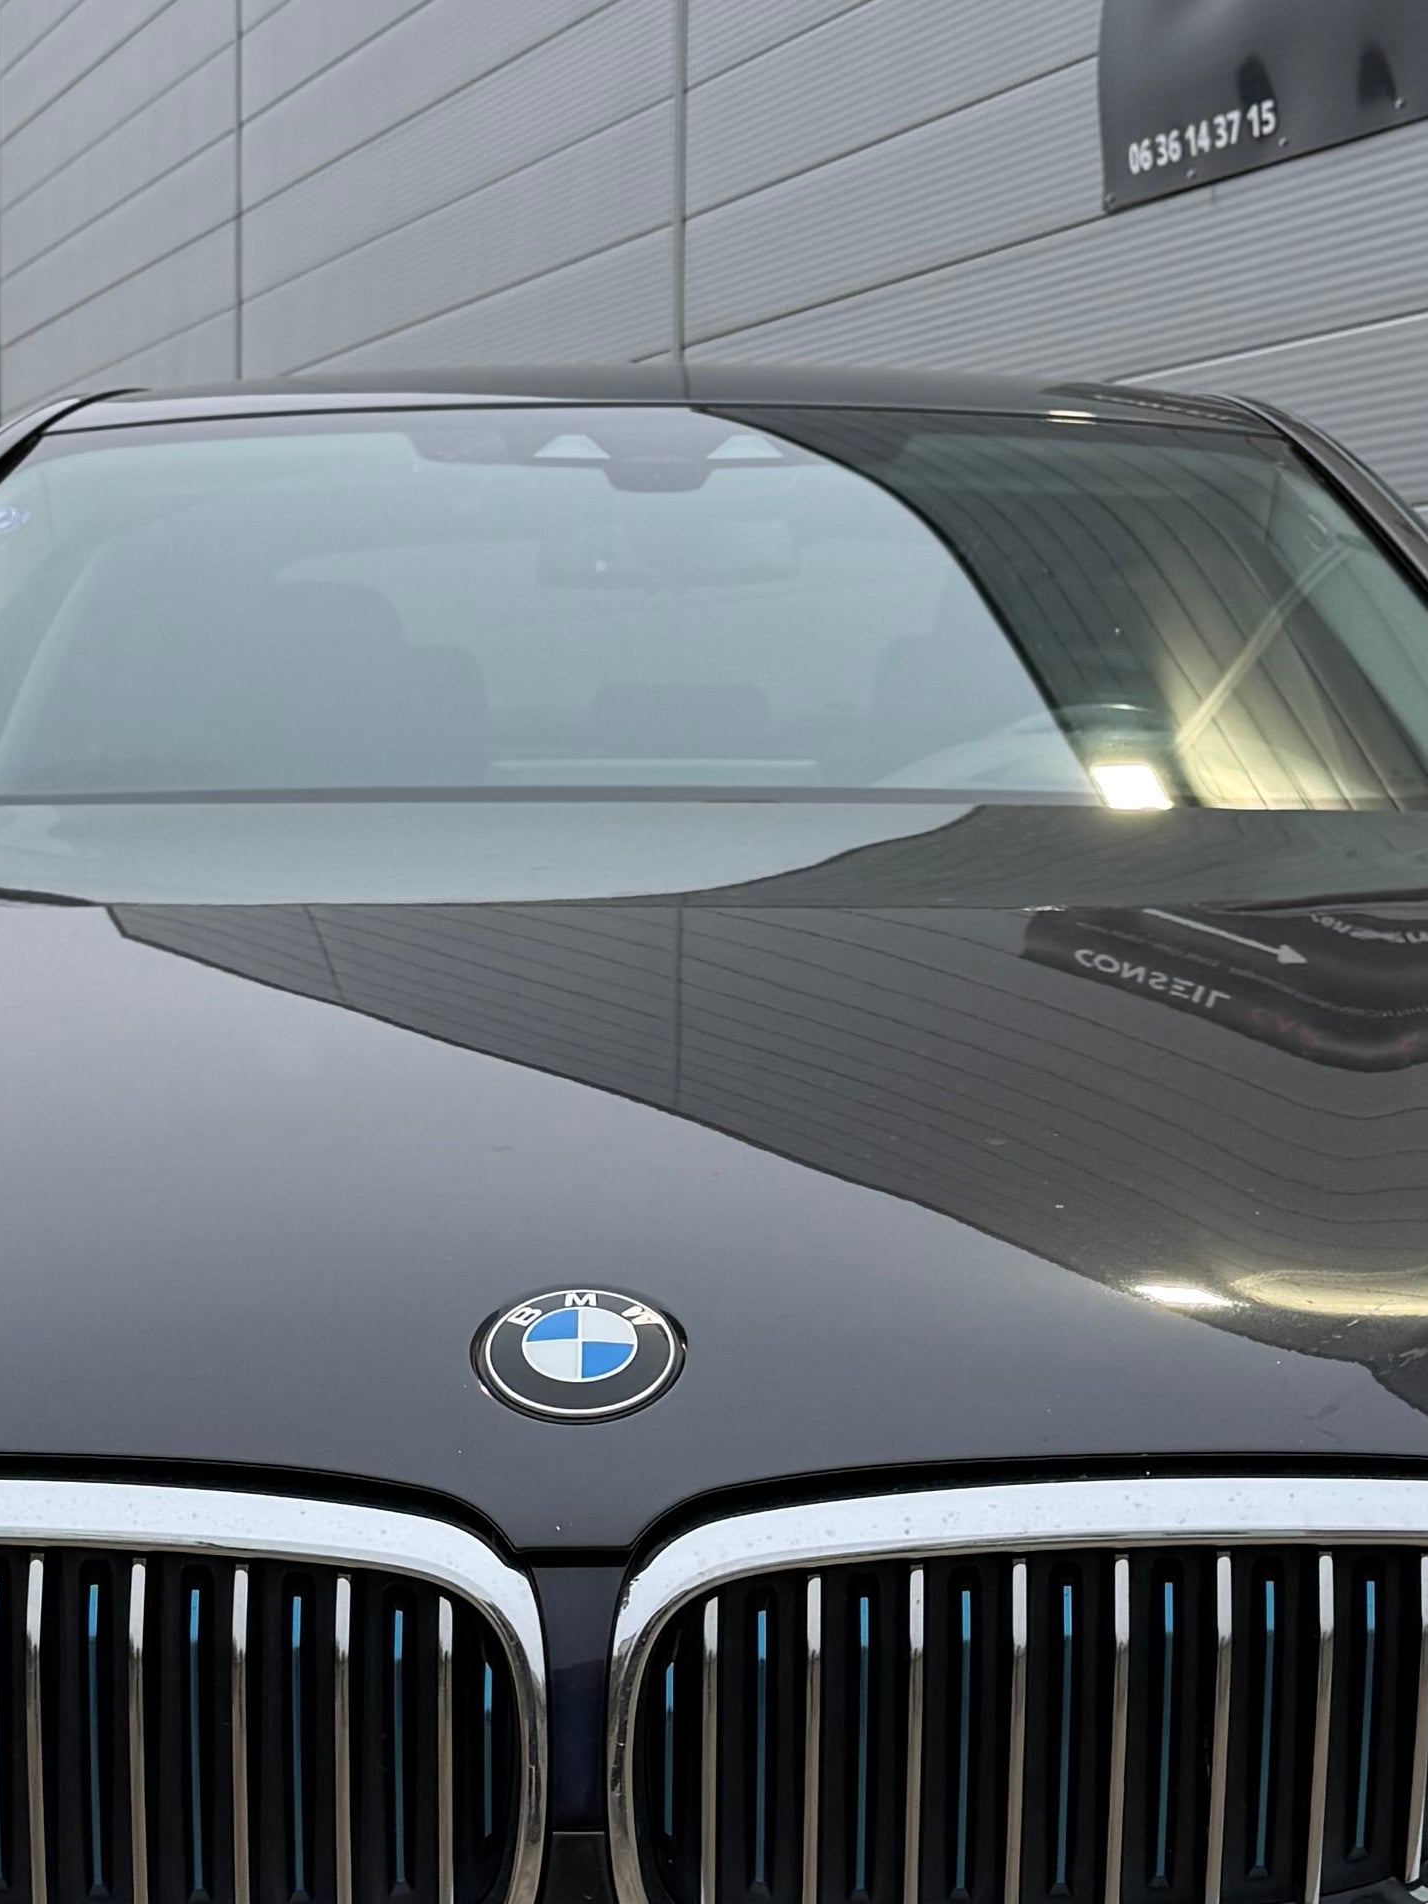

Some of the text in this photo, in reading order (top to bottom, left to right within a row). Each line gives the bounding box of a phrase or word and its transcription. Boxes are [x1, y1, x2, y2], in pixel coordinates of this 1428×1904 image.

[1128, 98, 1277, 175] 06 36 14 37 15
